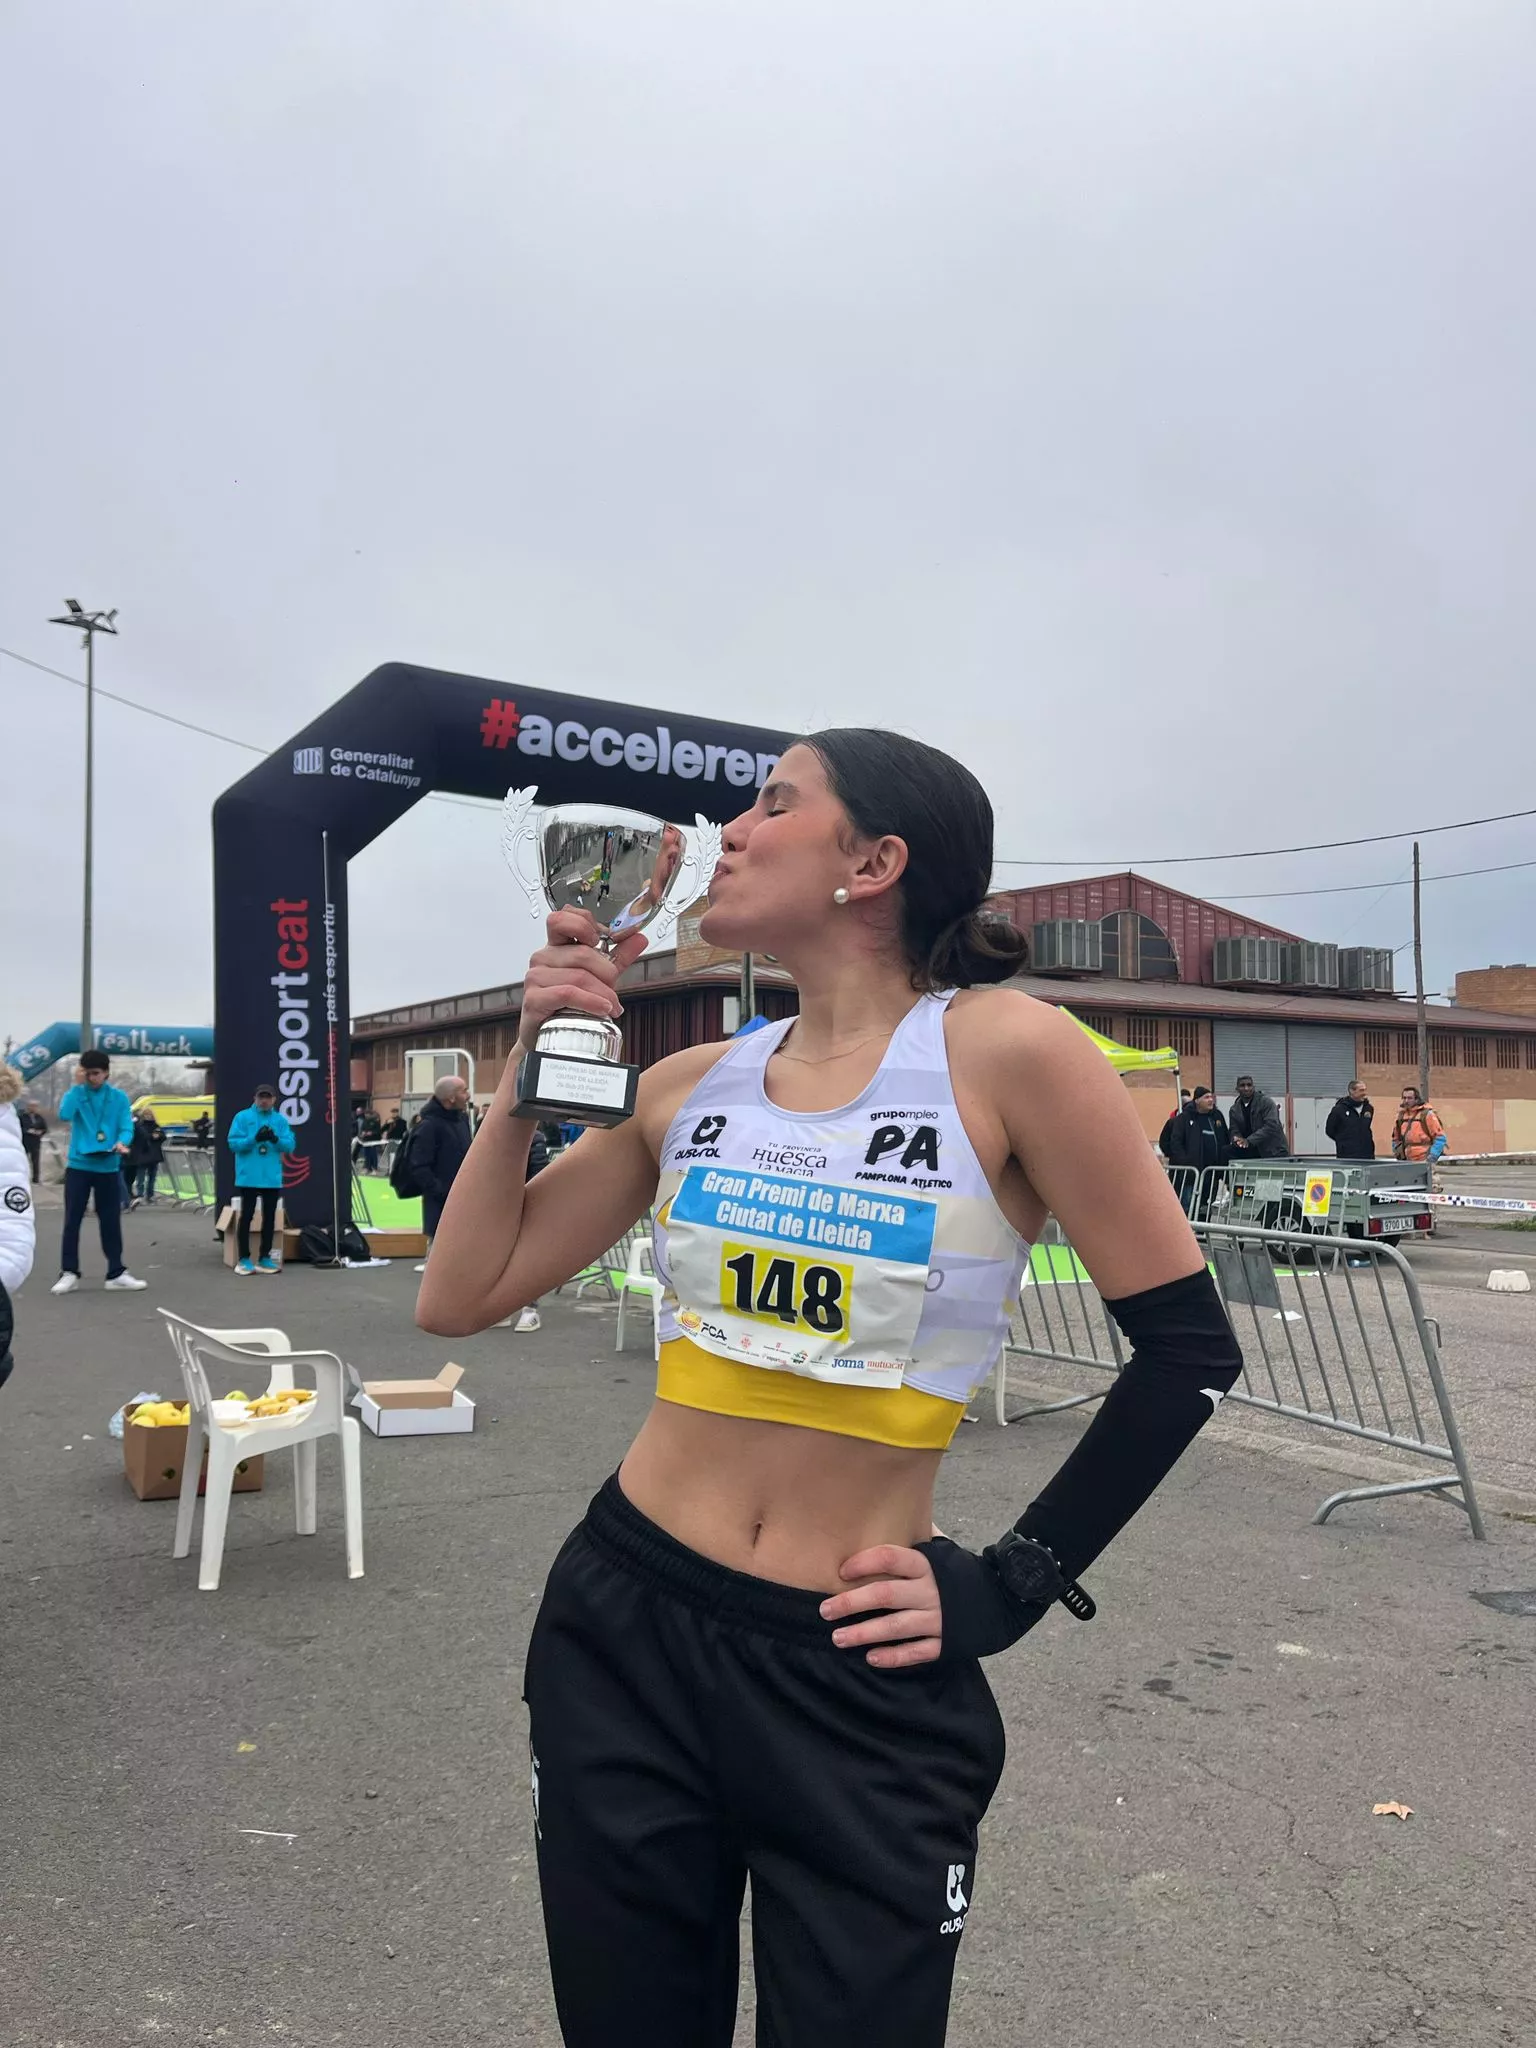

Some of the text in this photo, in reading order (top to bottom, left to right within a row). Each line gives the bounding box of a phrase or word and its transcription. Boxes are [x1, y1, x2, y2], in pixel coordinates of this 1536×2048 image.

[329, 747, 415, 770] Generalitat
[330, 763, 421, 789] de Catalunya
[322, 902, 338, 979] esportiu
[870, 1110, 939, 1121] grupompleo
[674, 1147, 721, 1160] austral
[864, 1125, 939, 1172] PA
[854, 1171, 953, 1189] PAMPLONA ATLETICO
[701, 1171, 907, 1227] Gran Premi de Marxa
[715, 1200, 873, 1251] Ciutat de Lleida
[726, 1252, 844, 1333] 148
[700, 1322, 728, 1342] FCA
